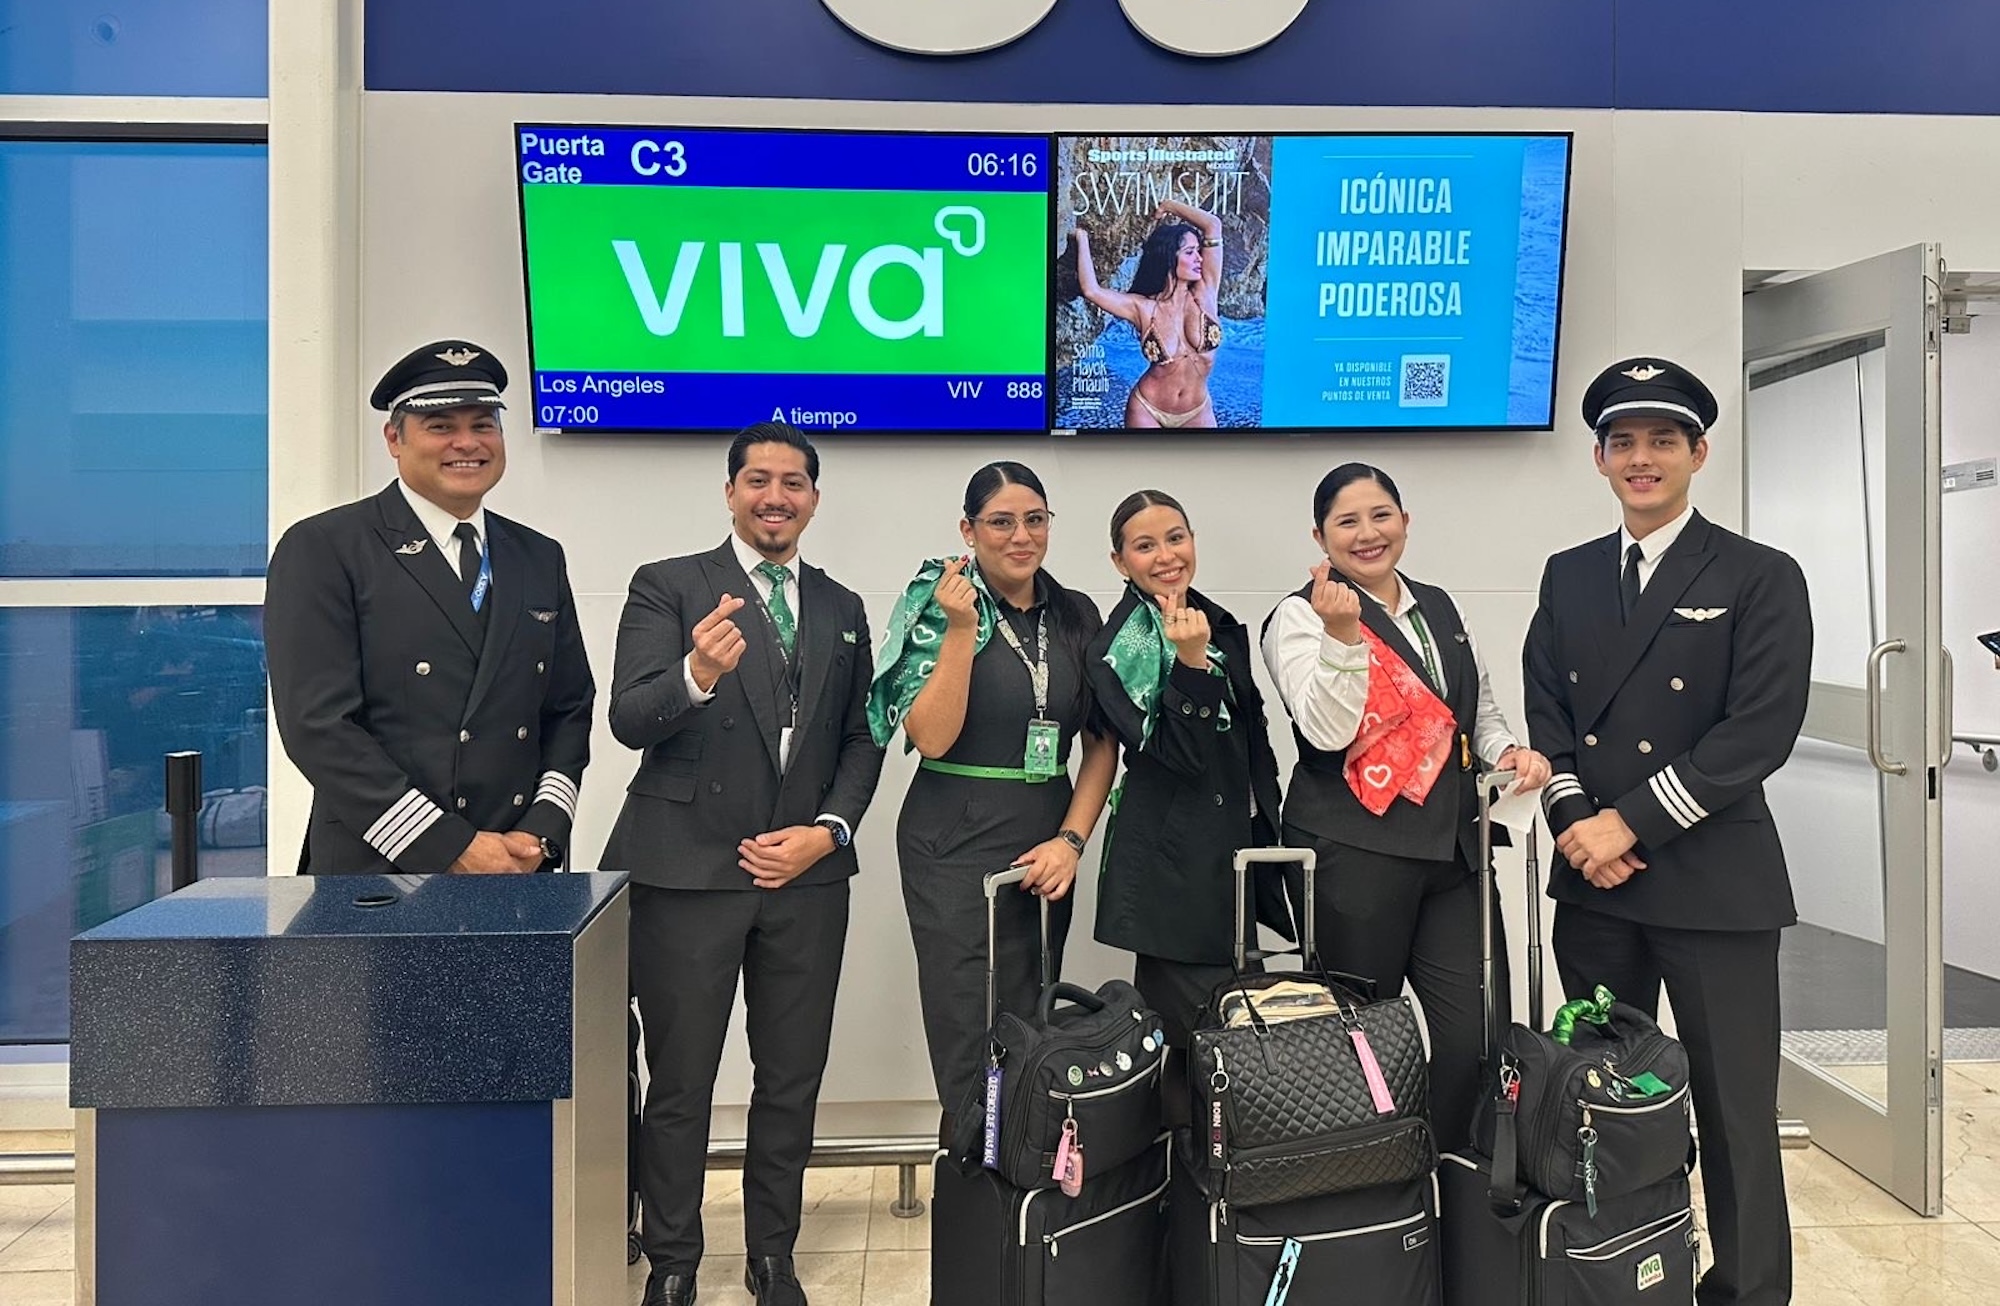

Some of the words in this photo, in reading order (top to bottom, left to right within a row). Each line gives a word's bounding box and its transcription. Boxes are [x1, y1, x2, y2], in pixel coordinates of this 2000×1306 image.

[520, 132, 605, 156] Puerta
[630, 139, 688, 178] C3
[967, 152, 1037, 177] 06:16
[1087, 149, 1147, 164] Sports
[1148, 148, 1235, 162] Illustrated
[522, 160, 583, 184] Gate
[1072, 171, 1250, 216] SWIMSUIT
[1340, 171, 1452, 215] ICÓNICA
[1316, 230, 1472, 267] IMPARABLE
[1318, 281, 1462, 318] PODEROSA
[1071, 342, 1106, 359] Salma
[1334, 361, 1344, 373] YA
[1346, 361, 1392, 373] DISPONIBLE
[540, 374, 577, 393] Los
[582, 374, 665, 398] Angeles
[947, 381, 983, 399] VIV
[1006, 381, 1043, 399] 888
[1072, 377, 1110, 393] Pinault
[1339, 376, 1350, 387] EN
[1351, 375, 1392, 387] NUESTROS
[1321, 390, 1353, 401] PUNTOS
[1354, 390, 1365, 401] DE
[1366, 390, 1391, 401] VENTA
[541, 405, 599, 424] 07:00
[771, 407, 787, 424] A
[790, 407, 858, 429] tiempo
[1212, 1101, 1221, 1127] BORN
[1212, 1142, 1222, 1158] FLY
